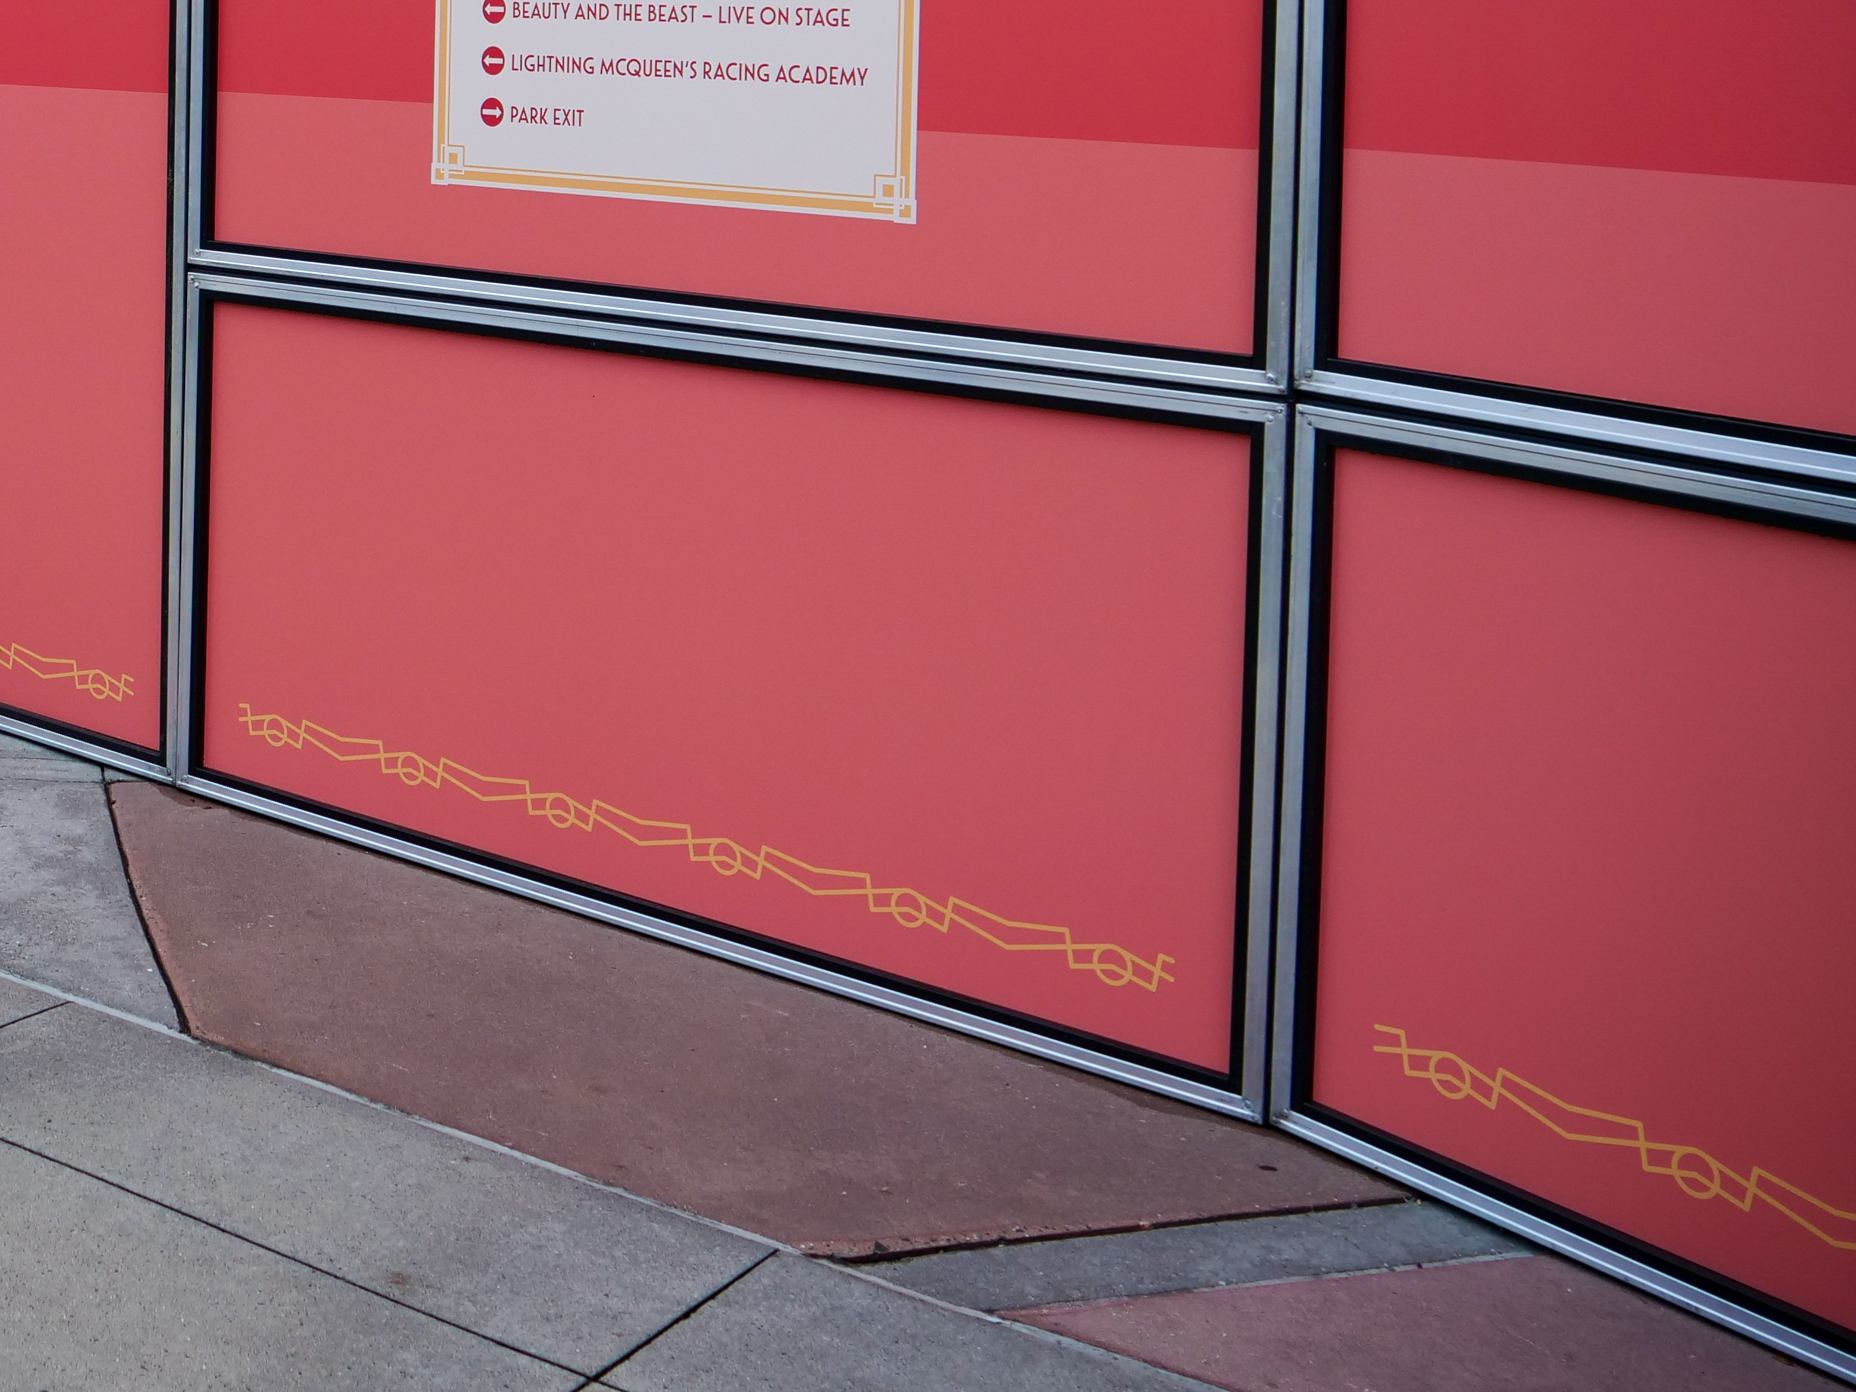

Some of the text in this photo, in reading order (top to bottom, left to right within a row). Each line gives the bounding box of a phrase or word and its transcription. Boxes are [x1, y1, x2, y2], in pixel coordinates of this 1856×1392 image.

[512, 2, 570, 20] BEAUTY
[574, 3, 610, 21] AND
[614, 3, 643, 22] THE
[648, 4, 697, 23] BEAST
[718, 6, 755, 25] LIVE
[760, 7, 790, 26] ON
[795, 7, 851, 27] STAGE
[511, 54, 869, 87] LIGHTNING MCQUEEN'S RACING ACADEMY
[510, 106, 584, 127] PARK EXIT
